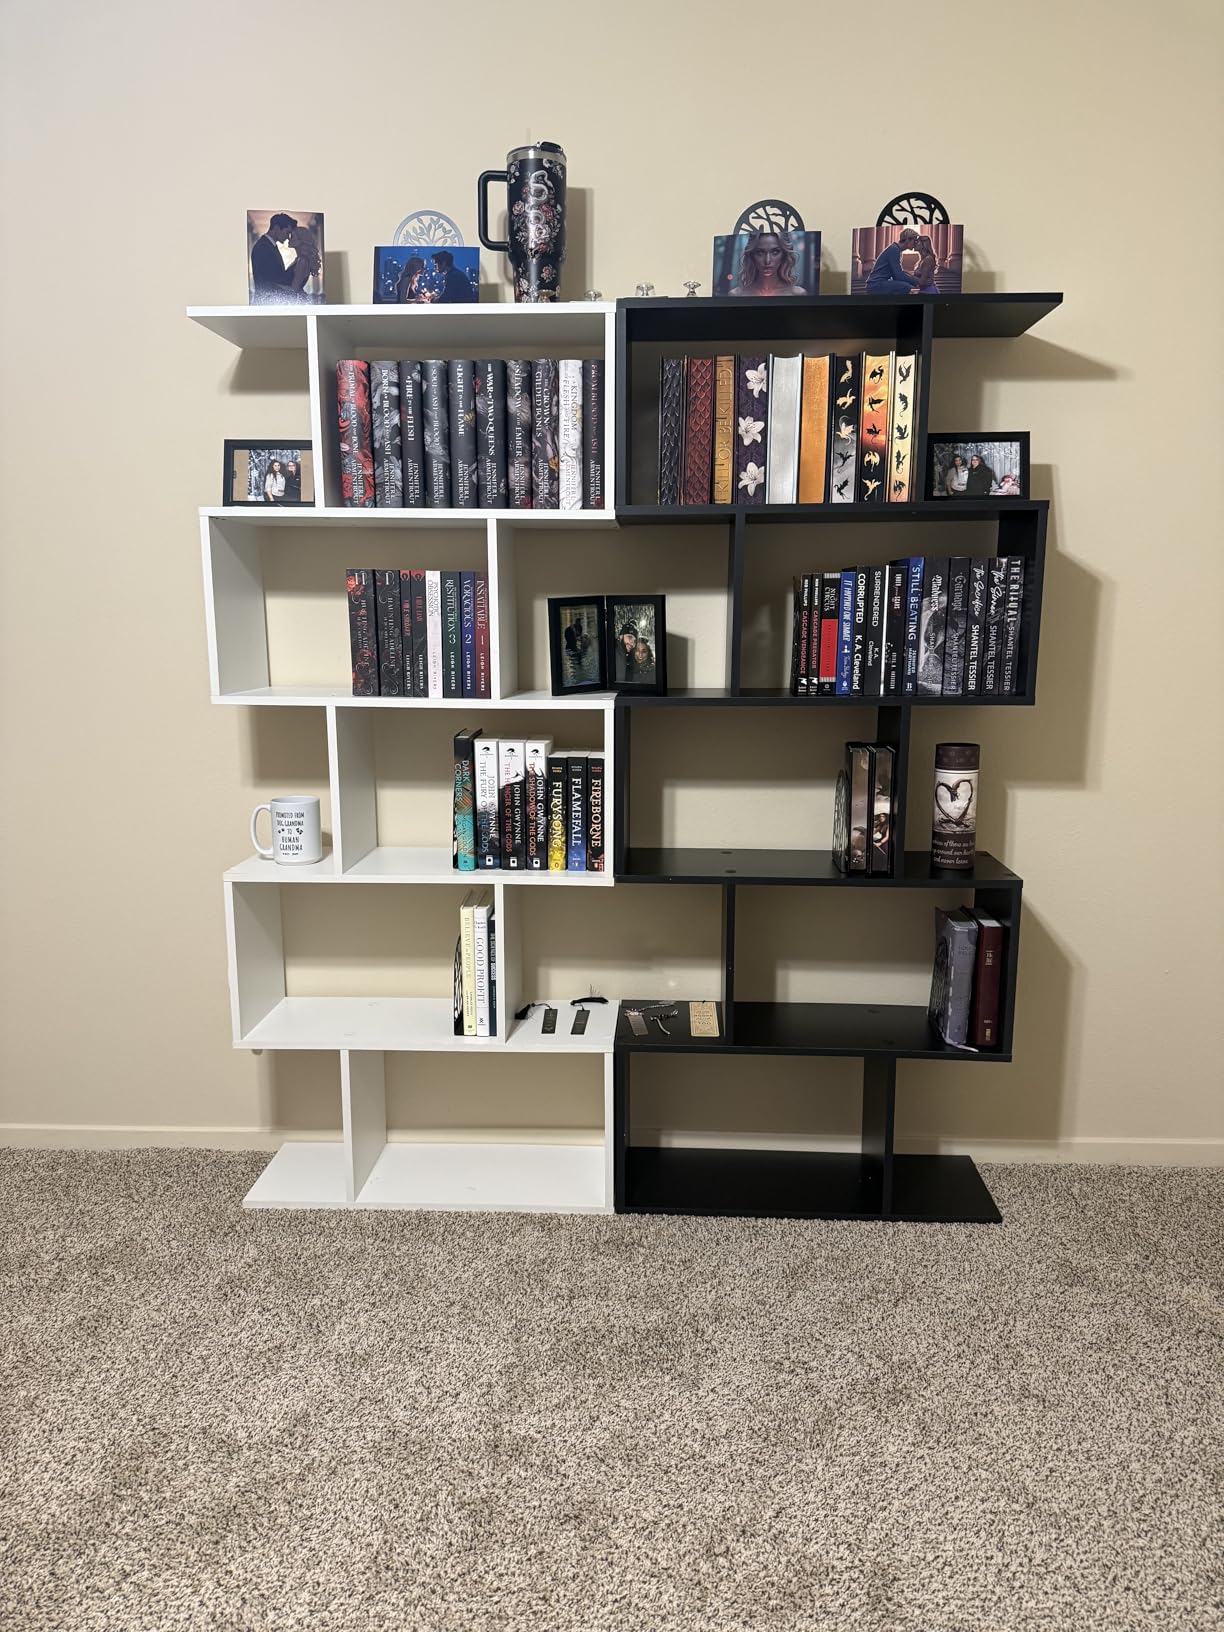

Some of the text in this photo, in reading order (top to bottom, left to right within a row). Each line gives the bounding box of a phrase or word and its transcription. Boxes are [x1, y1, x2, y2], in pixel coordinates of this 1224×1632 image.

[351, 403, 359, 427] BLOOD
[383, 400, 391, 427] BLOOD
[405, 380, 415, 441] FIRE FLESH
[456, 368, 465, 437] LIGHT FLAME
[514, 369, 523, 457] SHADOW EMBER
[535, 371, 544, 438] GILDED BONES
[486, 422, 496, 456] QUEENS
[383, 459, 392, 504] ARMENTROUT
[407, 458, 415, 504] ARMENTROUT
[432, 459, 440, 504] ARMENTROUT
[457, 459, 465, 505] ARMENTROUT
[485, 458, 493, 504] ARMENTROUT
[589, 459, 597, 505] ARMENTROUT
[445, 579, 455, 632] RESTITUTION
[462, 579, 472, 629] VORACIOUS
[477, 580, 486, 630] INSATIABLE
[823, 587, 831, 612] CIRCUS
[855, 573, 866, 623] CORRUPTED
[871, 570, 881, 627] SURRENDERED
[908, 566, 921, 641] STILL BEATING
[930, 575, 943, 612] Madness
[951, 576, 967, 612] Carnage
[971, 565, 985, 617] The Sacrifice
[989, 566, 1006, 616] The Sinner
[1007, 559, 1021, 623] THE RITUAL
[388, 598, 397, 669] HAUNTING ADELINE
[449, 634, 456, 644] 3
[464, 633, 471, 644] 2
[799, 639, 807, 675] VENGEANCE
[852, 635, 863, 690] K. A. Cleveland
[950, 632, 960, 690] SHANTEL TESSIER
[968, 624, 980, 690] SHANTEL TESSIER
[985, 625, 998, 691] SHANTEL TESSIER
[1003, 626, 1014, 691] SHANTEL TESSIER
[455, 763, 463, 802] CORNERS
[462, 760, 470, 783] DARK
[479, 760, 487, 777] THE
[480, 778, 488, 799] FURY
[487, 774, 495, 799] JOHN
[503, 762, 511, 776] THE
[536, 776, 544, 801] JOHN
[480, 800, 488, 811] OF
[504, 777, 512, 807] HUNGER
[505, 808, 513, 818] OF
[513, 783, 521, 806] JOHN
[528, 776, 536, 811] SHADOW
[551, 781, 562, 848] FURYSONG
[571, 777, 582, 847] FLAMEFALL
[590, 778, 602, 848] FIREBORNE
[529, 811, 536, 821] OF
[481, 831, 489, 853] GODS
[505, 834, 514, 853] GODS
[529, 836, 537, 857] GODS
[476, 937, 485, 966] GOOD
[477, 969, 486, 1004] PROFIT
